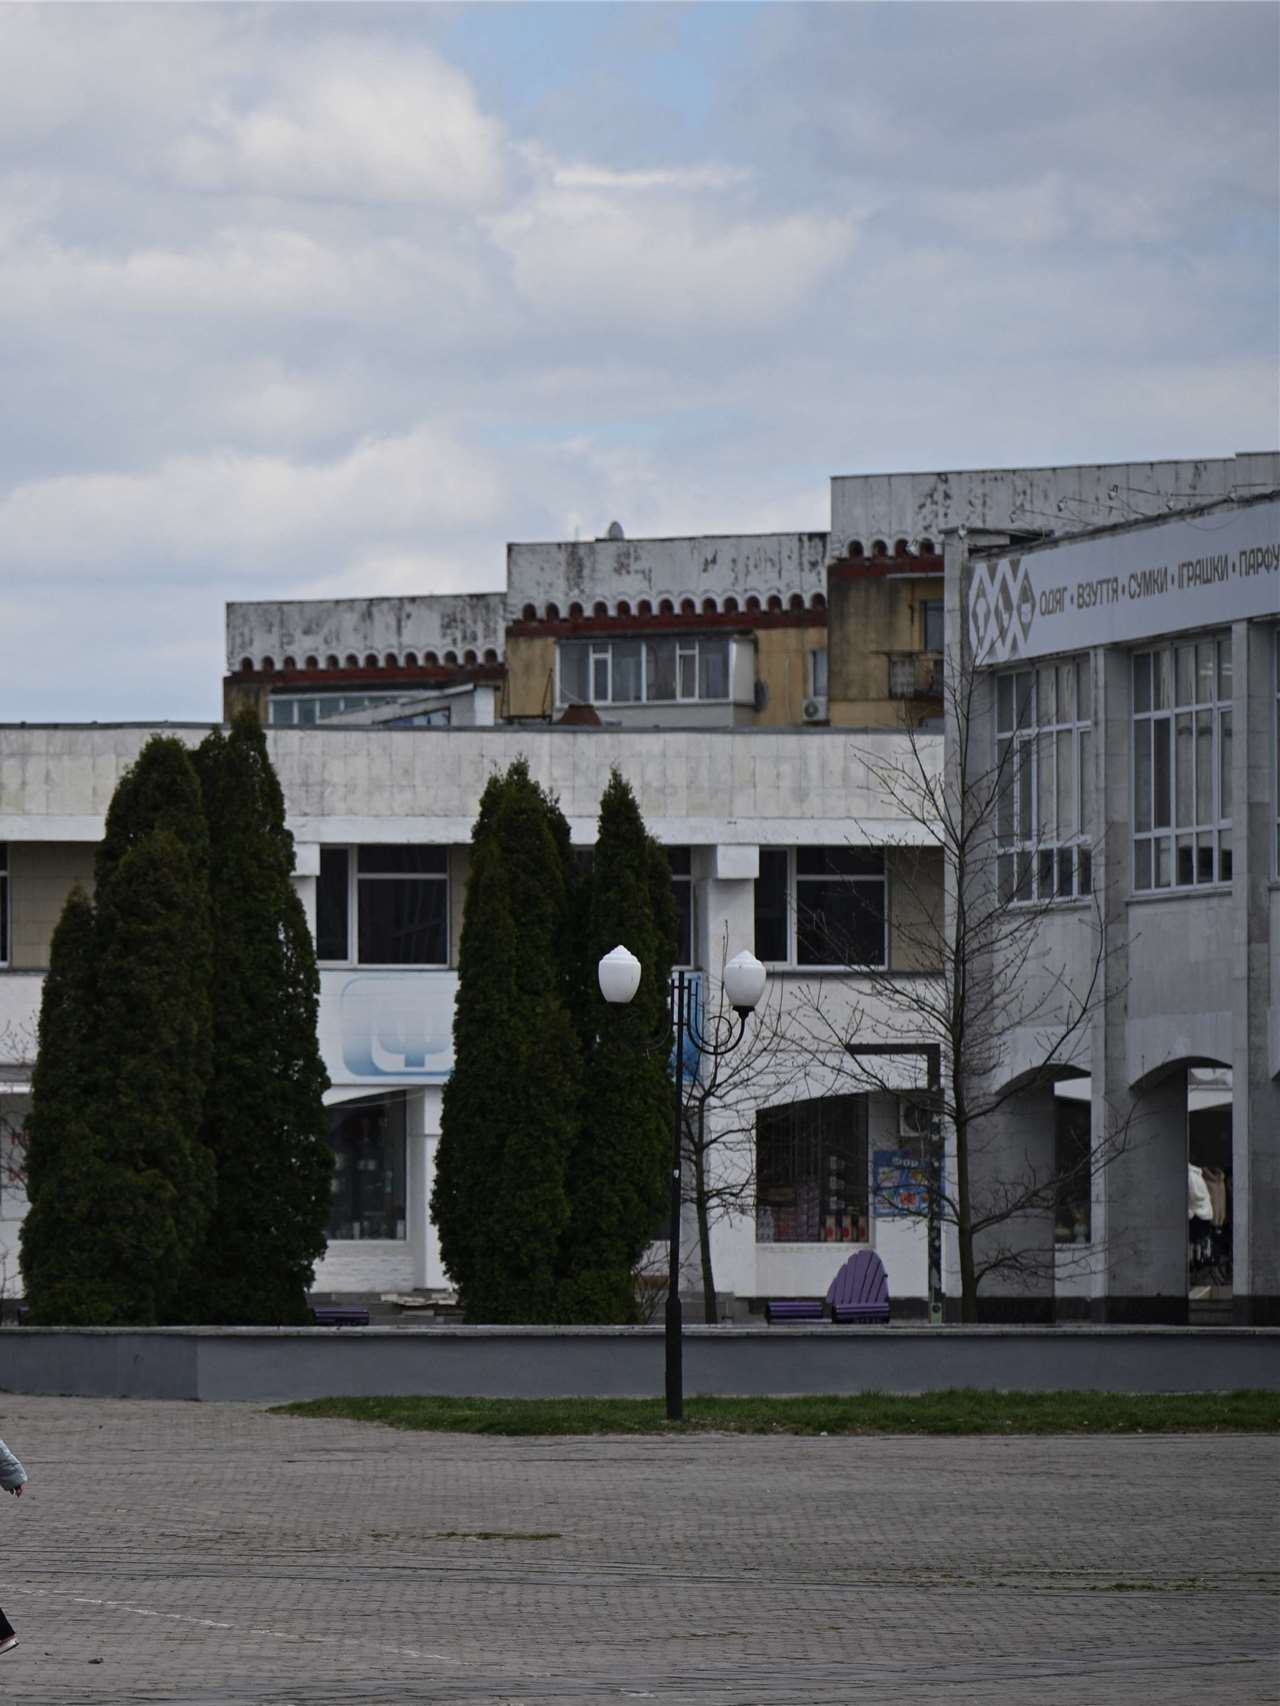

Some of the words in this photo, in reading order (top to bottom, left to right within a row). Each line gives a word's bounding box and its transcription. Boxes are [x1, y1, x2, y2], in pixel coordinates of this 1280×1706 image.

[1039, 585, 1068, 617] ОДЯГ
[1076, 576, 1119, 610] ВЗУТТЯ
[1128, 566, 1168, 600] СУМКИ
[1177, 553, 1229, 591] ІГРАШКИ
